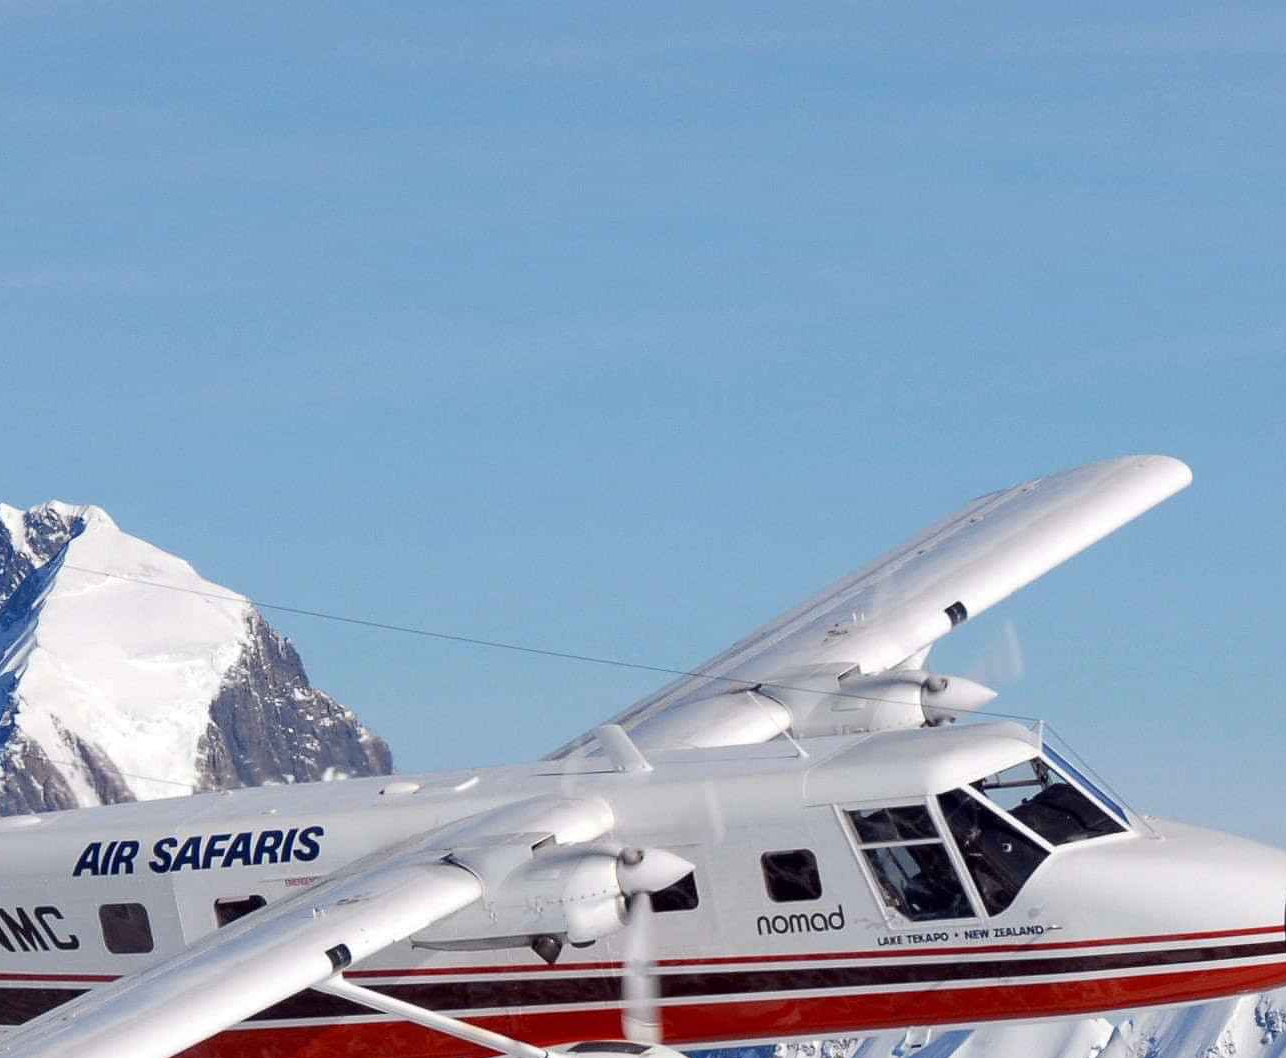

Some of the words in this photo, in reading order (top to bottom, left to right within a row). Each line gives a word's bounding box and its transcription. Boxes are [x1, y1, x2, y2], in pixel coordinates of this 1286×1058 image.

[73, 840, 140, 877] AIR
[149, 826, 324, 873] SAFARIS
[757, 904, 845, 935] nomad
[877, 934, 903, 946] LAKE
[906, 932, 949, 944] TEKAPO
[964, 929, 989, 939] NEW
[993, 925, 1044, 938] ZEALAND
